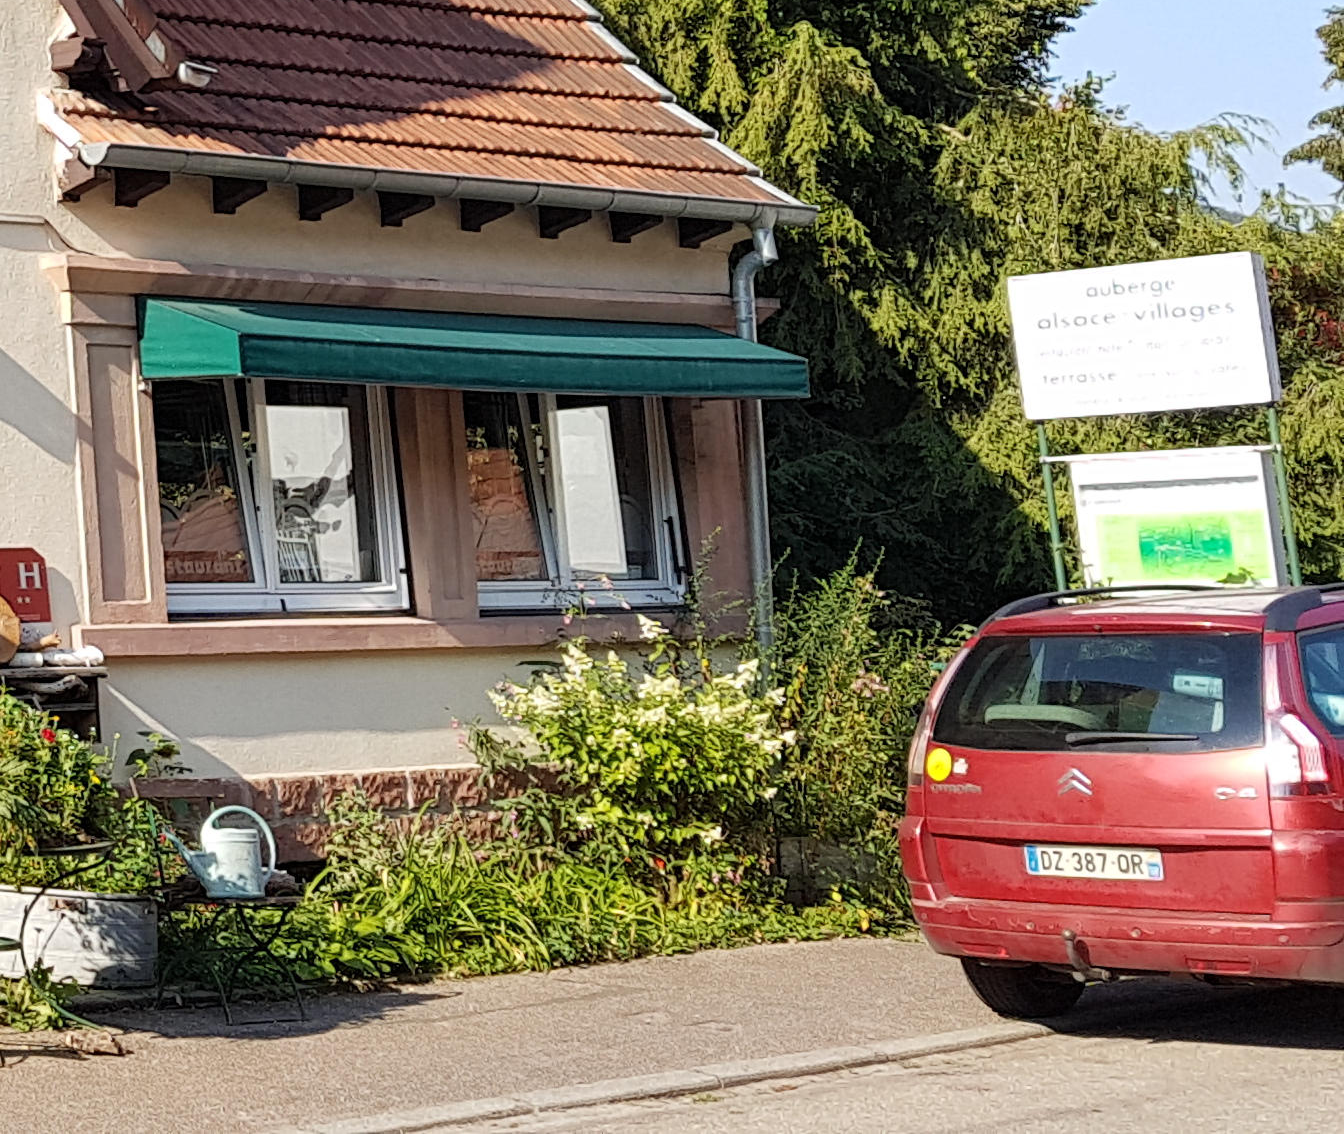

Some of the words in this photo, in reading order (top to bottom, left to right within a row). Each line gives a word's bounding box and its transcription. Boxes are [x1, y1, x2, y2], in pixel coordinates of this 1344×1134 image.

[1086, 279, 1176, 298] auberge
[1042, 370, 1117, 386] terrasse
[17, 561, 43, 590] H
